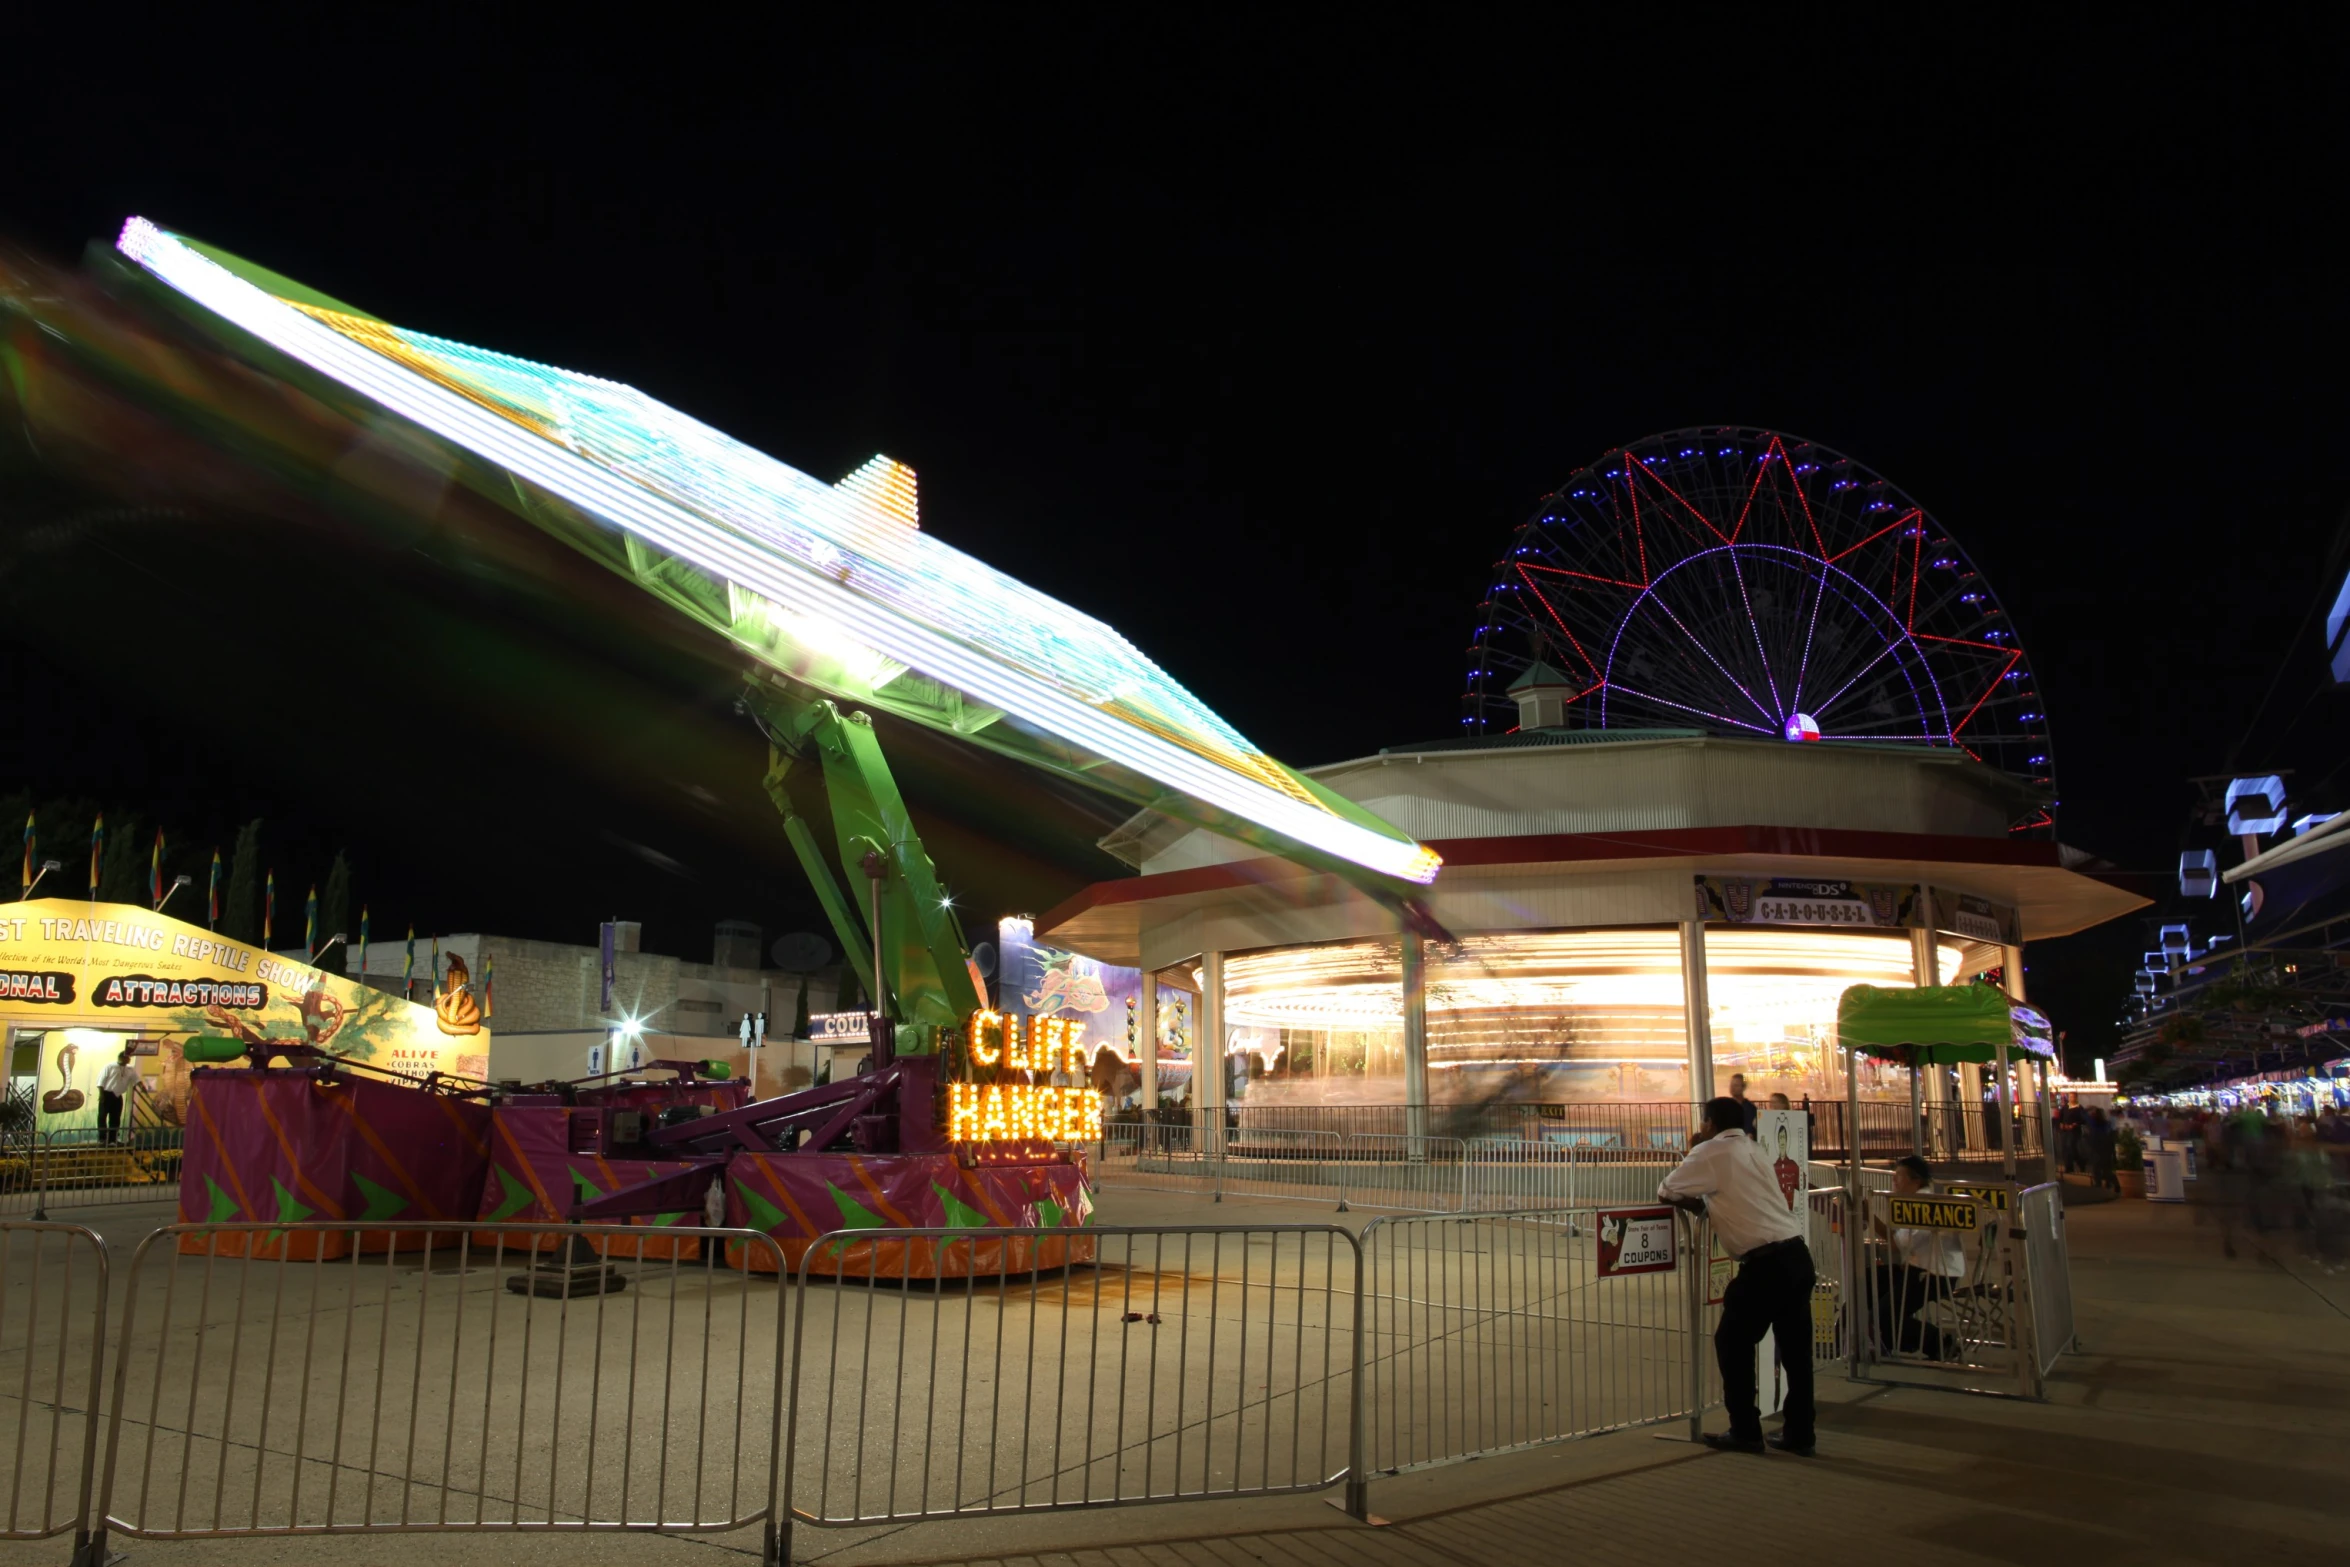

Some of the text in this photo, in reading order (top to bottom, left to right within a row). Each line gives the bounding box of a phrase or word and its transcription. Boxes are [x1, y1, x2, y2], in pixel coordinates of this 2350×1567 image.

[32, 954, 42, 964] of
[43, 955, 55, 965] the
[88, 957, 110, 967] Most
[112, 959, 153, 970] Dangerous
[157, 961, 182, 970] Snakes
[40, 918, 166, 951] TRAVELING
[171, 933, 251, 973] REPTILE
[256, 957, 316, 996] SHOW
[106, 980, 260, 1006] ATTRACTIONS
[967, 1008, 1087, 1072] CLIFF
[391, 1049, 439, 1059] ALIVE
[391, 1060, 435, 1069] COBRAS
[947, 1083, 1103, 1141] HANGER
[1893, 1201, 1974, 1228] ENTRANCE
[1641, 1233, 1649, 1248] 8
[1624, 1249, 1668, 1263] COUPONS
